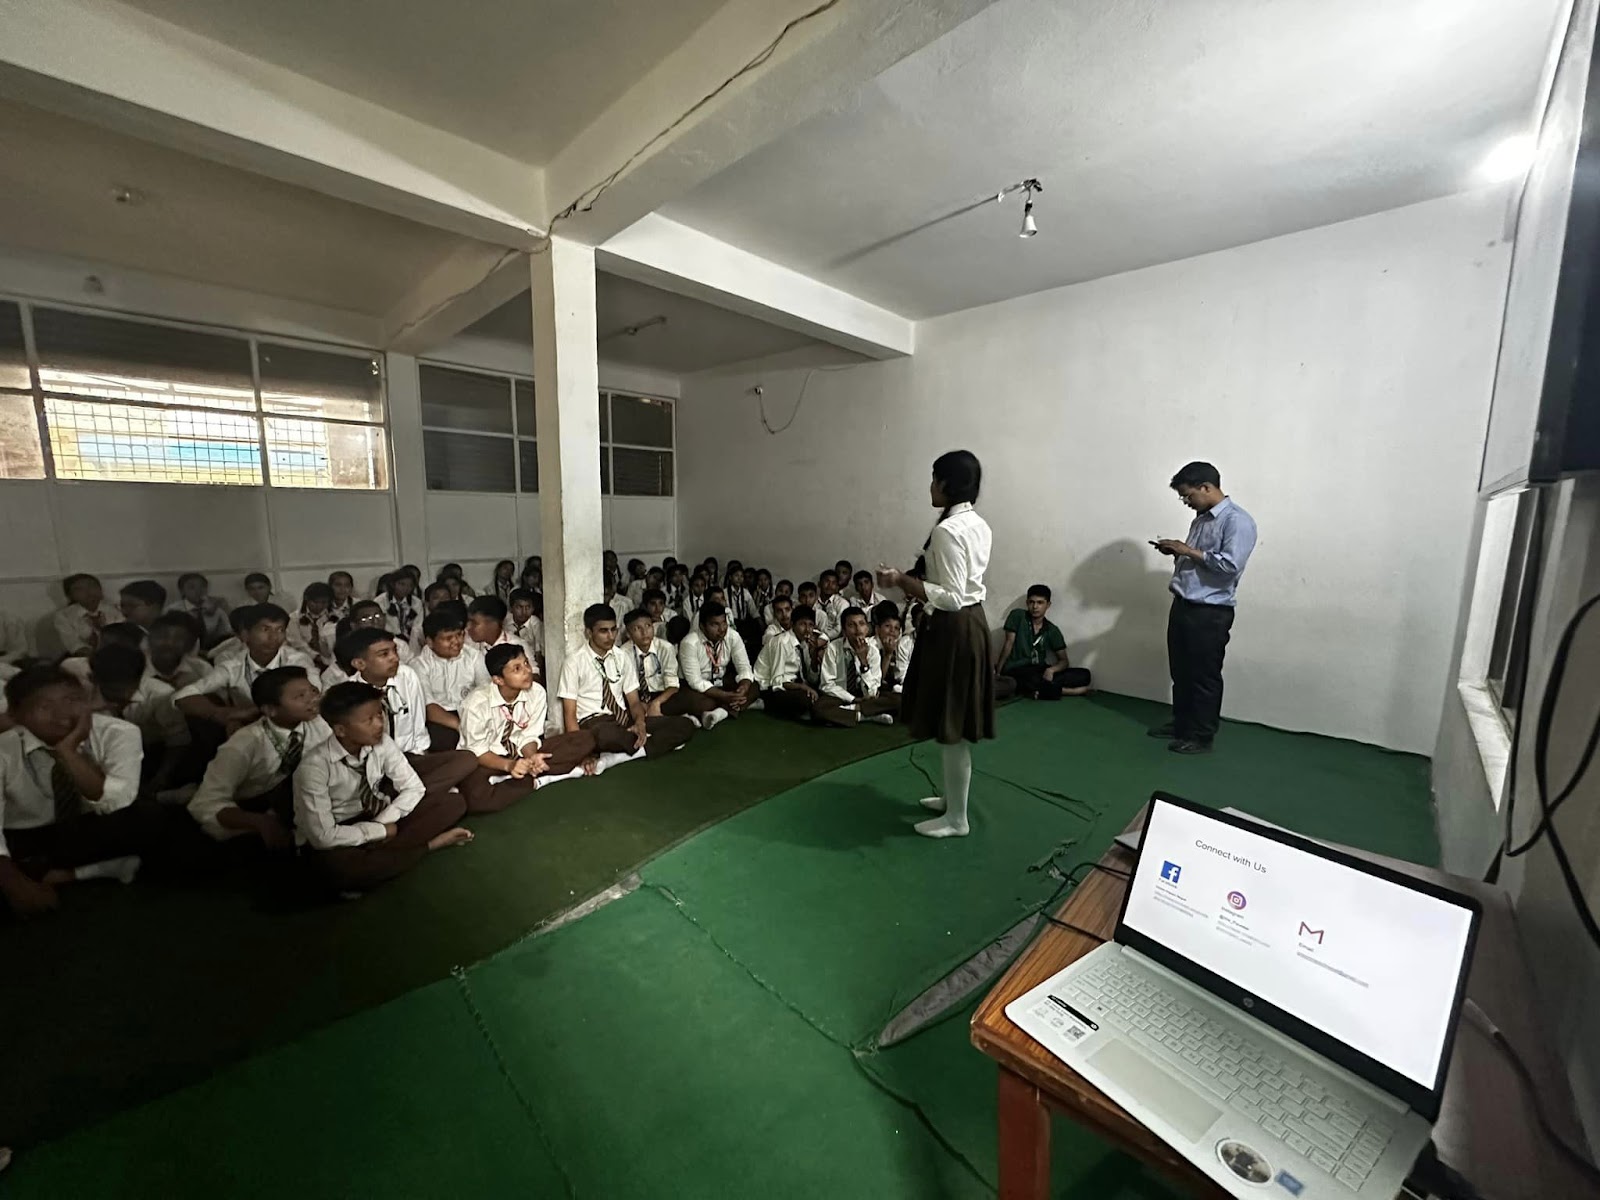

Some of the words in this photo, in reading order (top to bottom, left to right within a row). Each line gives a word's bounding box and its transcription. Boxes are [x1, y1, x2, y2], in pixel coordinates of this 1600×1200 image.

[1195, 839, 1231, 860] Connect
[1233, 854, 1251, 867] with
[1253, 862, 1267, 873] Us
